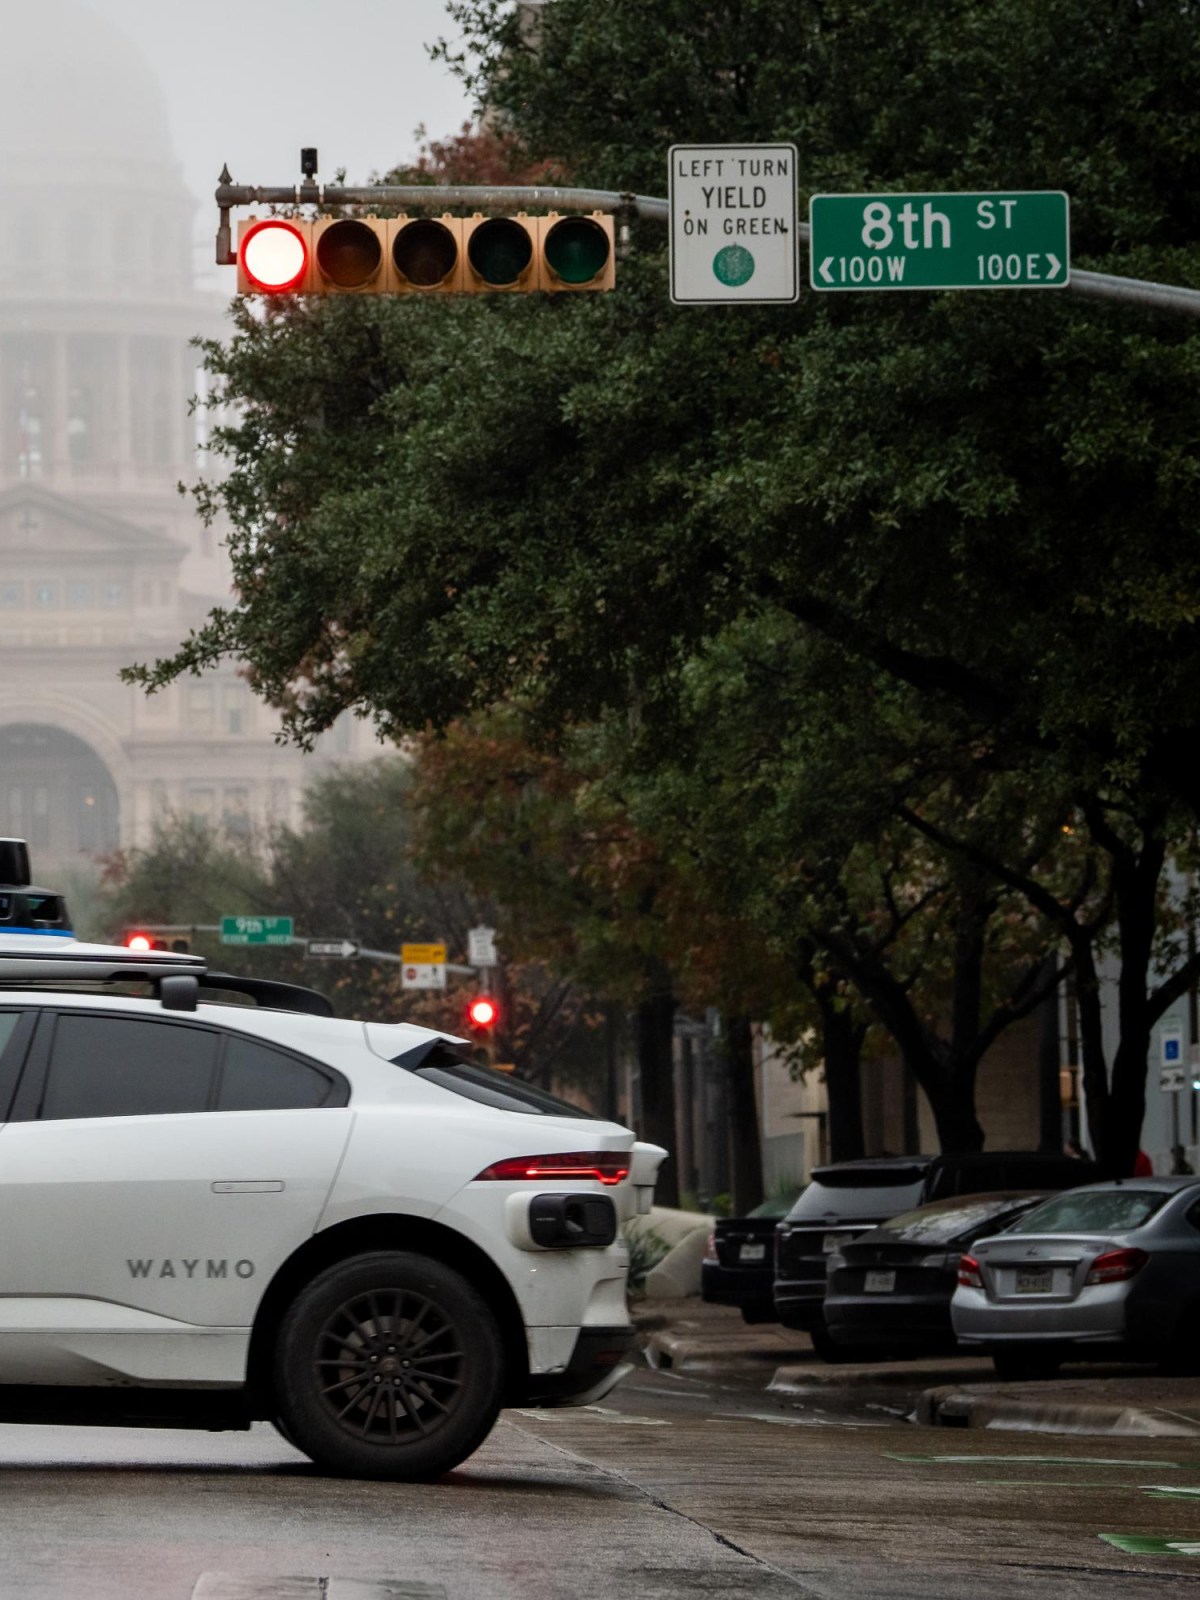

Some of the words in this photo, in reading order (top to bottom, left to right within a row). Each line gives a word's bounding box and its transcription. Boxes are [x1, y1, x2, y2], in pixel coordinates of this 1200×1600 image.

[679, 159, 724, 177] LEFT
[738, 159, 788, 176] TURN
[701, 186, 766, 209] YIELD
[683, 218, 708, 236] ON
[723, 217, 785, 235] GREEN
[861, 201, 951, 250] 8th
[976, 199, 1018, 230] ST
[839, 255, 906, 282] 100W
[977, 253, 1041, 280] 100E
[126, 1258, 256, 1279] WAYMO
